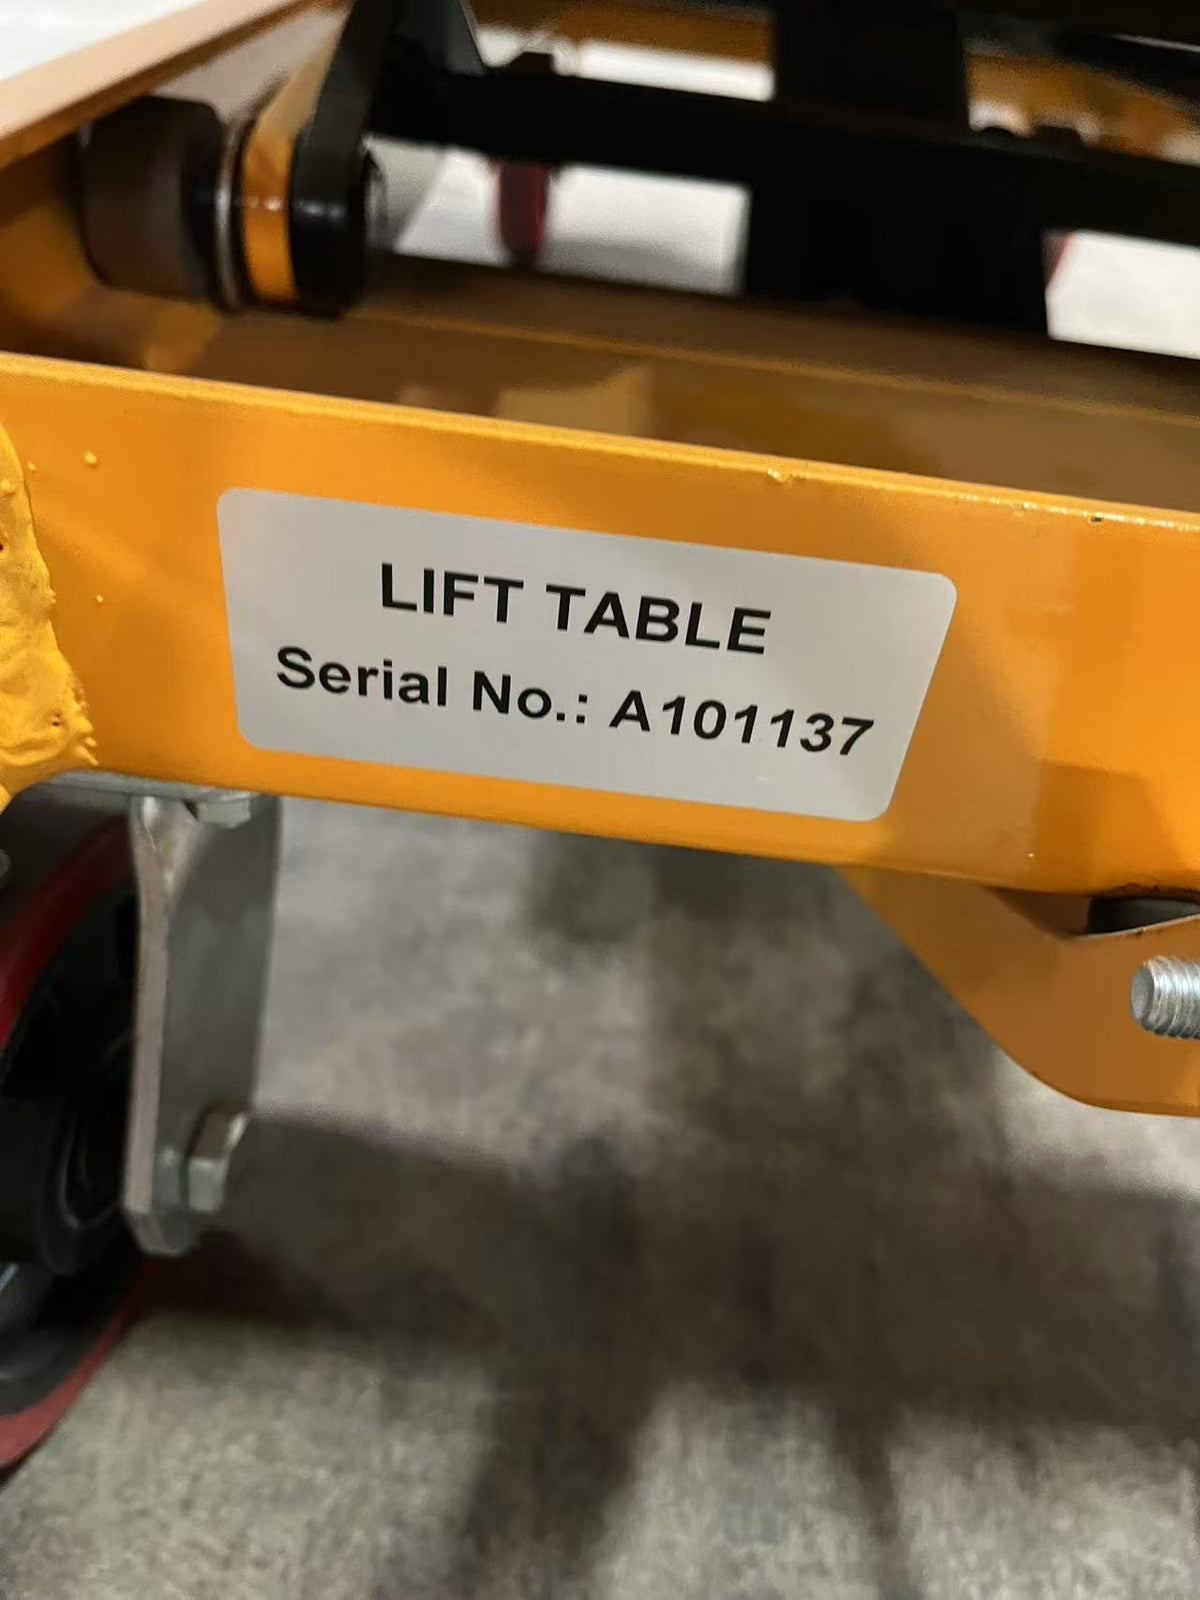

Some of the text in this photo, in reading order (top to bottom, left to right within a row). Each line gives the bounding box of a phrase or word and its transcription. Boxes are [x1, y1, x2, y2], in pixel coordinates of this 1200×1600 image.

[381, 561, 773, 655] LIFT TABLE
[276, 645, 876, 757] Serial No.: A101137
